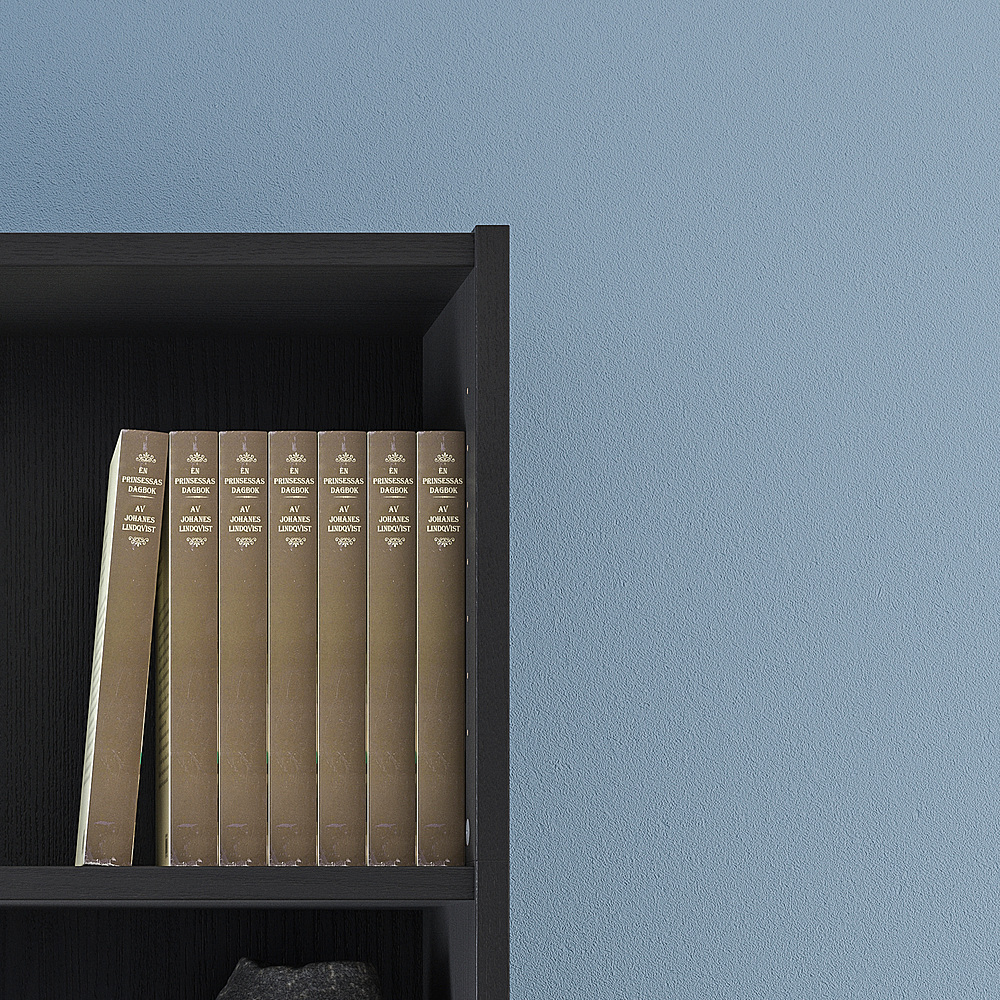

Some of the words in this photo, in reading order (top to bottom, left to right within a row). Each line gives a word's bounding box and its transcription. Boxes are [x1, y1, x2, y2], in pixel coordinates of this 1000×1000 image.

[138, 467, 148, 475] EN
[190, 467, 200, 475] EN
[438, 467, 448, 475] EN
[121, 476, 163, 486] PRINSESSAS
[174, 477, 216, 485] PRINSESSAS
[422, 477, 464, 485] PRINSESSAS
[128, 486, 157, 495] DAGBOK
[134, 505, 146, 513] AV
[190, 505, 201, 513] AV
[438, 505, 449, 513] AV
[124, 515, 156, 523] JOHANES
[121, 524, 156, 533] LINDQVIST
[178, 525, 213, 533] LINDQVIST
[426, 525, 461, 533] LINDQVIST
